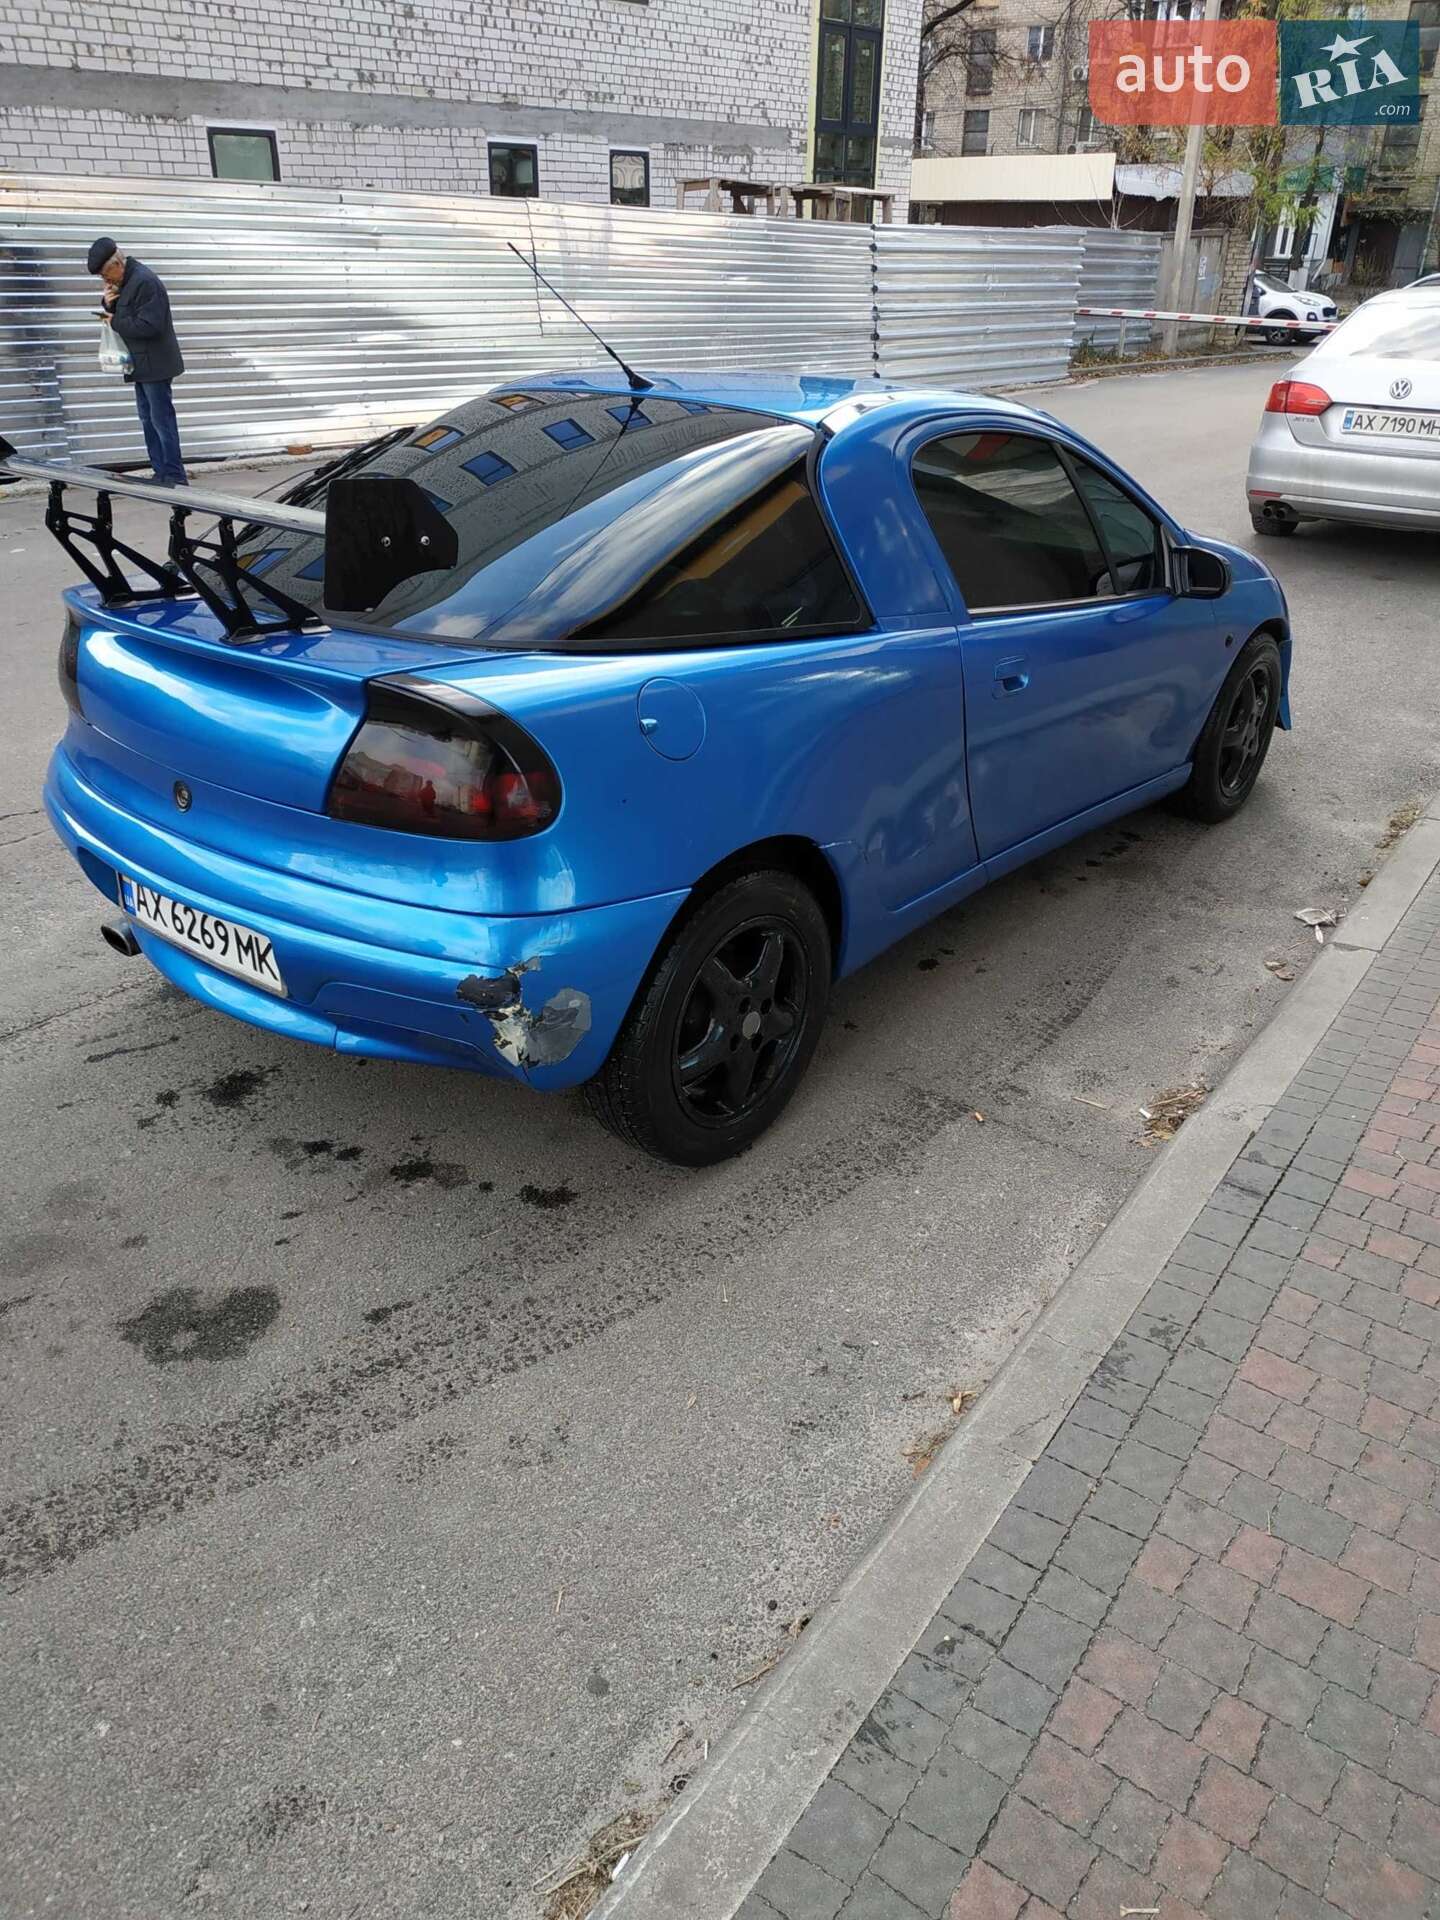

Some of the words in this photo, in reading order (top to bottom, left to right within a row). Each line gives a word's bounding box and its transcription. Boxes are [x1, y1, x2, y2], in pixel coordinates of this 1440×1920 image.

[1352, 415, 1377, 431] AX
[1380, 415, 1416, 433] 7190
[137, 884, 168, 928] AX
[171, 901, 229, 956] 6269
[234, 927, 279, 981] MK
